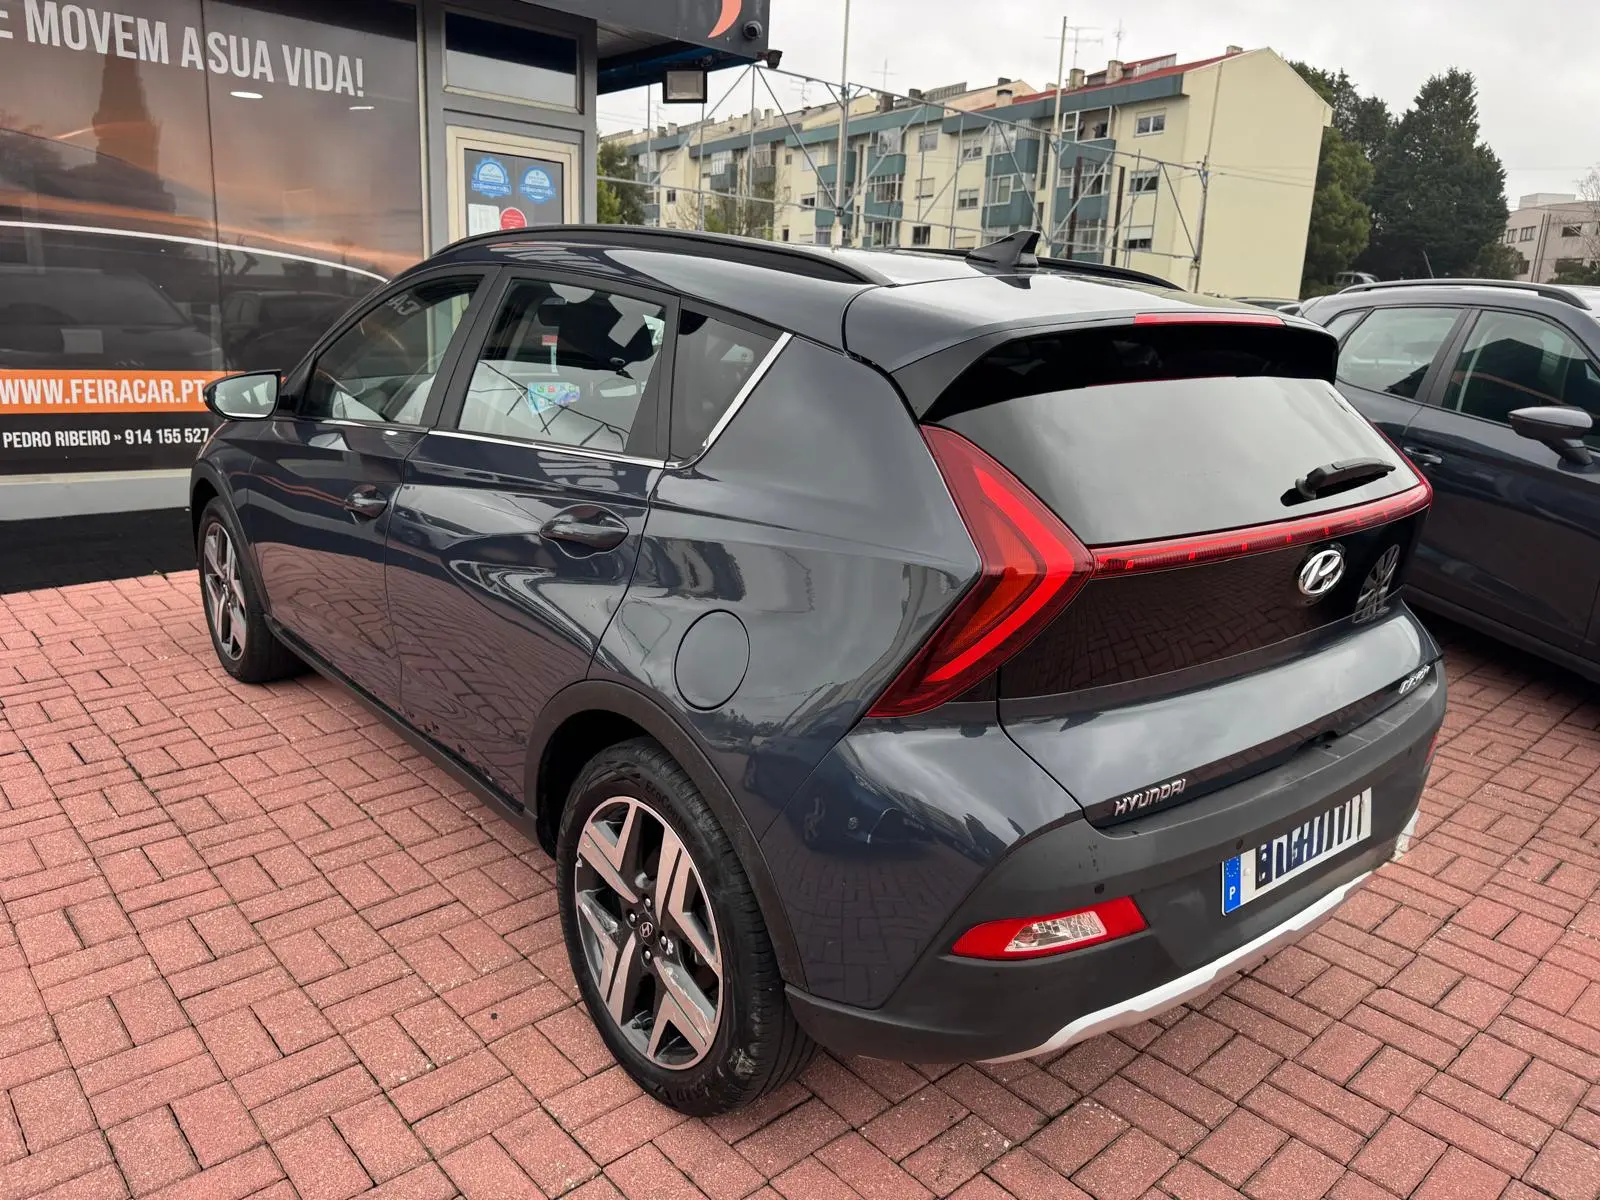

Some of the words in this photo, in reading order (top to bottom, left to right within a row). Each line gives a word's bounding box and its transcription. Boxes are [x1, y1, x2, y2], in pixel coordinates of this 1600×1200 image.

[24, 0, 169, 65] MOVEM
[282, 44, 365, 97] VIDA!
[0, 378, 205, 405] WWW.FEIRACAR.PT
[3, 431, 52, 448] PEDRO
[55, 429, 111, 447] RIBEIRO
[125, 428, 152, 445] 914
[156, 428, 182, 444] 155
[185, 427, 209, 443] 527
[1114, 778, 1186, 816] HYUNDAI
[1229, 885, 1236, 901] P
